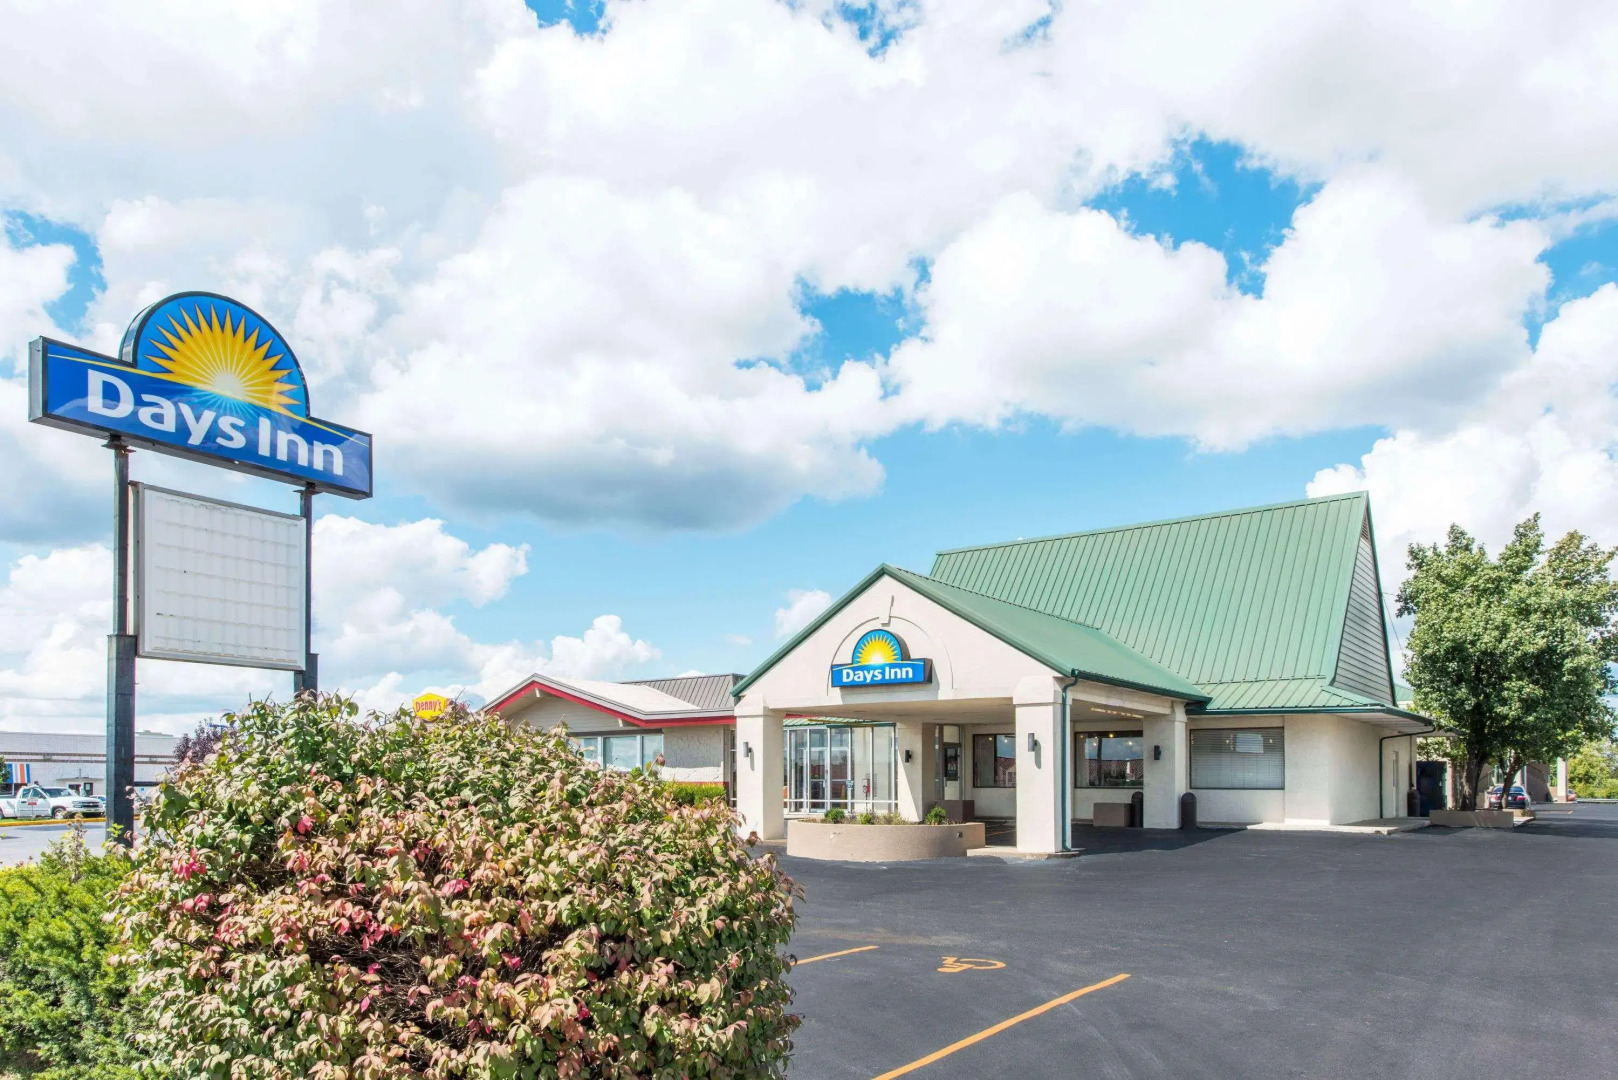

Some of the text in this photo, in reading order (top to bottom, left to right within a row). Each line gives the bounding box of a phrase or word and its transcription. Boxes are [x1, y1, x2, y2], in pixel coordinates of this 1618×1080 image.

[87, 368, 343, 476] Days Inn
[842, 666, 913, 682] Days Inn
[415, 699, 442, 712] Denny's
